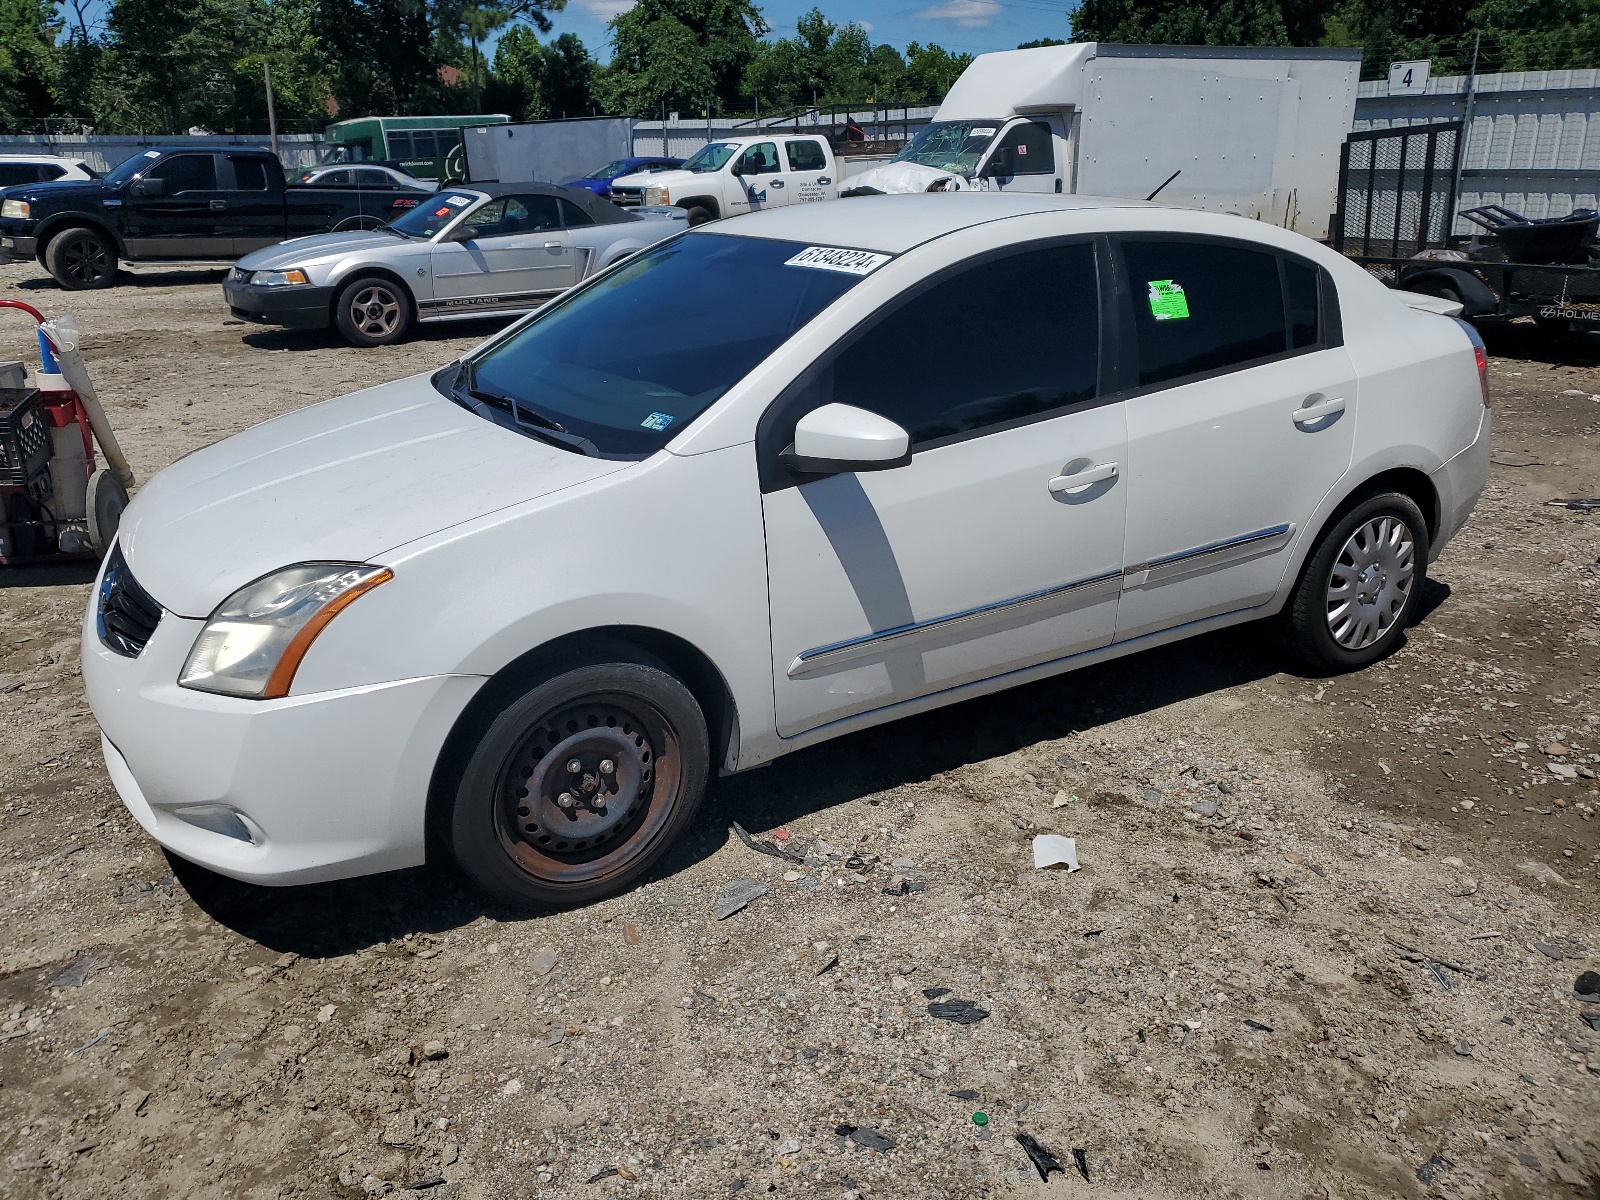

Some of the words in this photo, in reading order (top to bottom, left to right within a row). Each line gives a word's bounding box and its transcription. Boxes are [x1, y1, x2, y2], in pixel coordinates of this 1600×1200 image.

[1402, 68, 1413, 87] 4
[799, 248, 875, 268] 61348224
[446, 298, 499, 306] MUSTANG
[1557, 309, 1600, 320] HOLME
